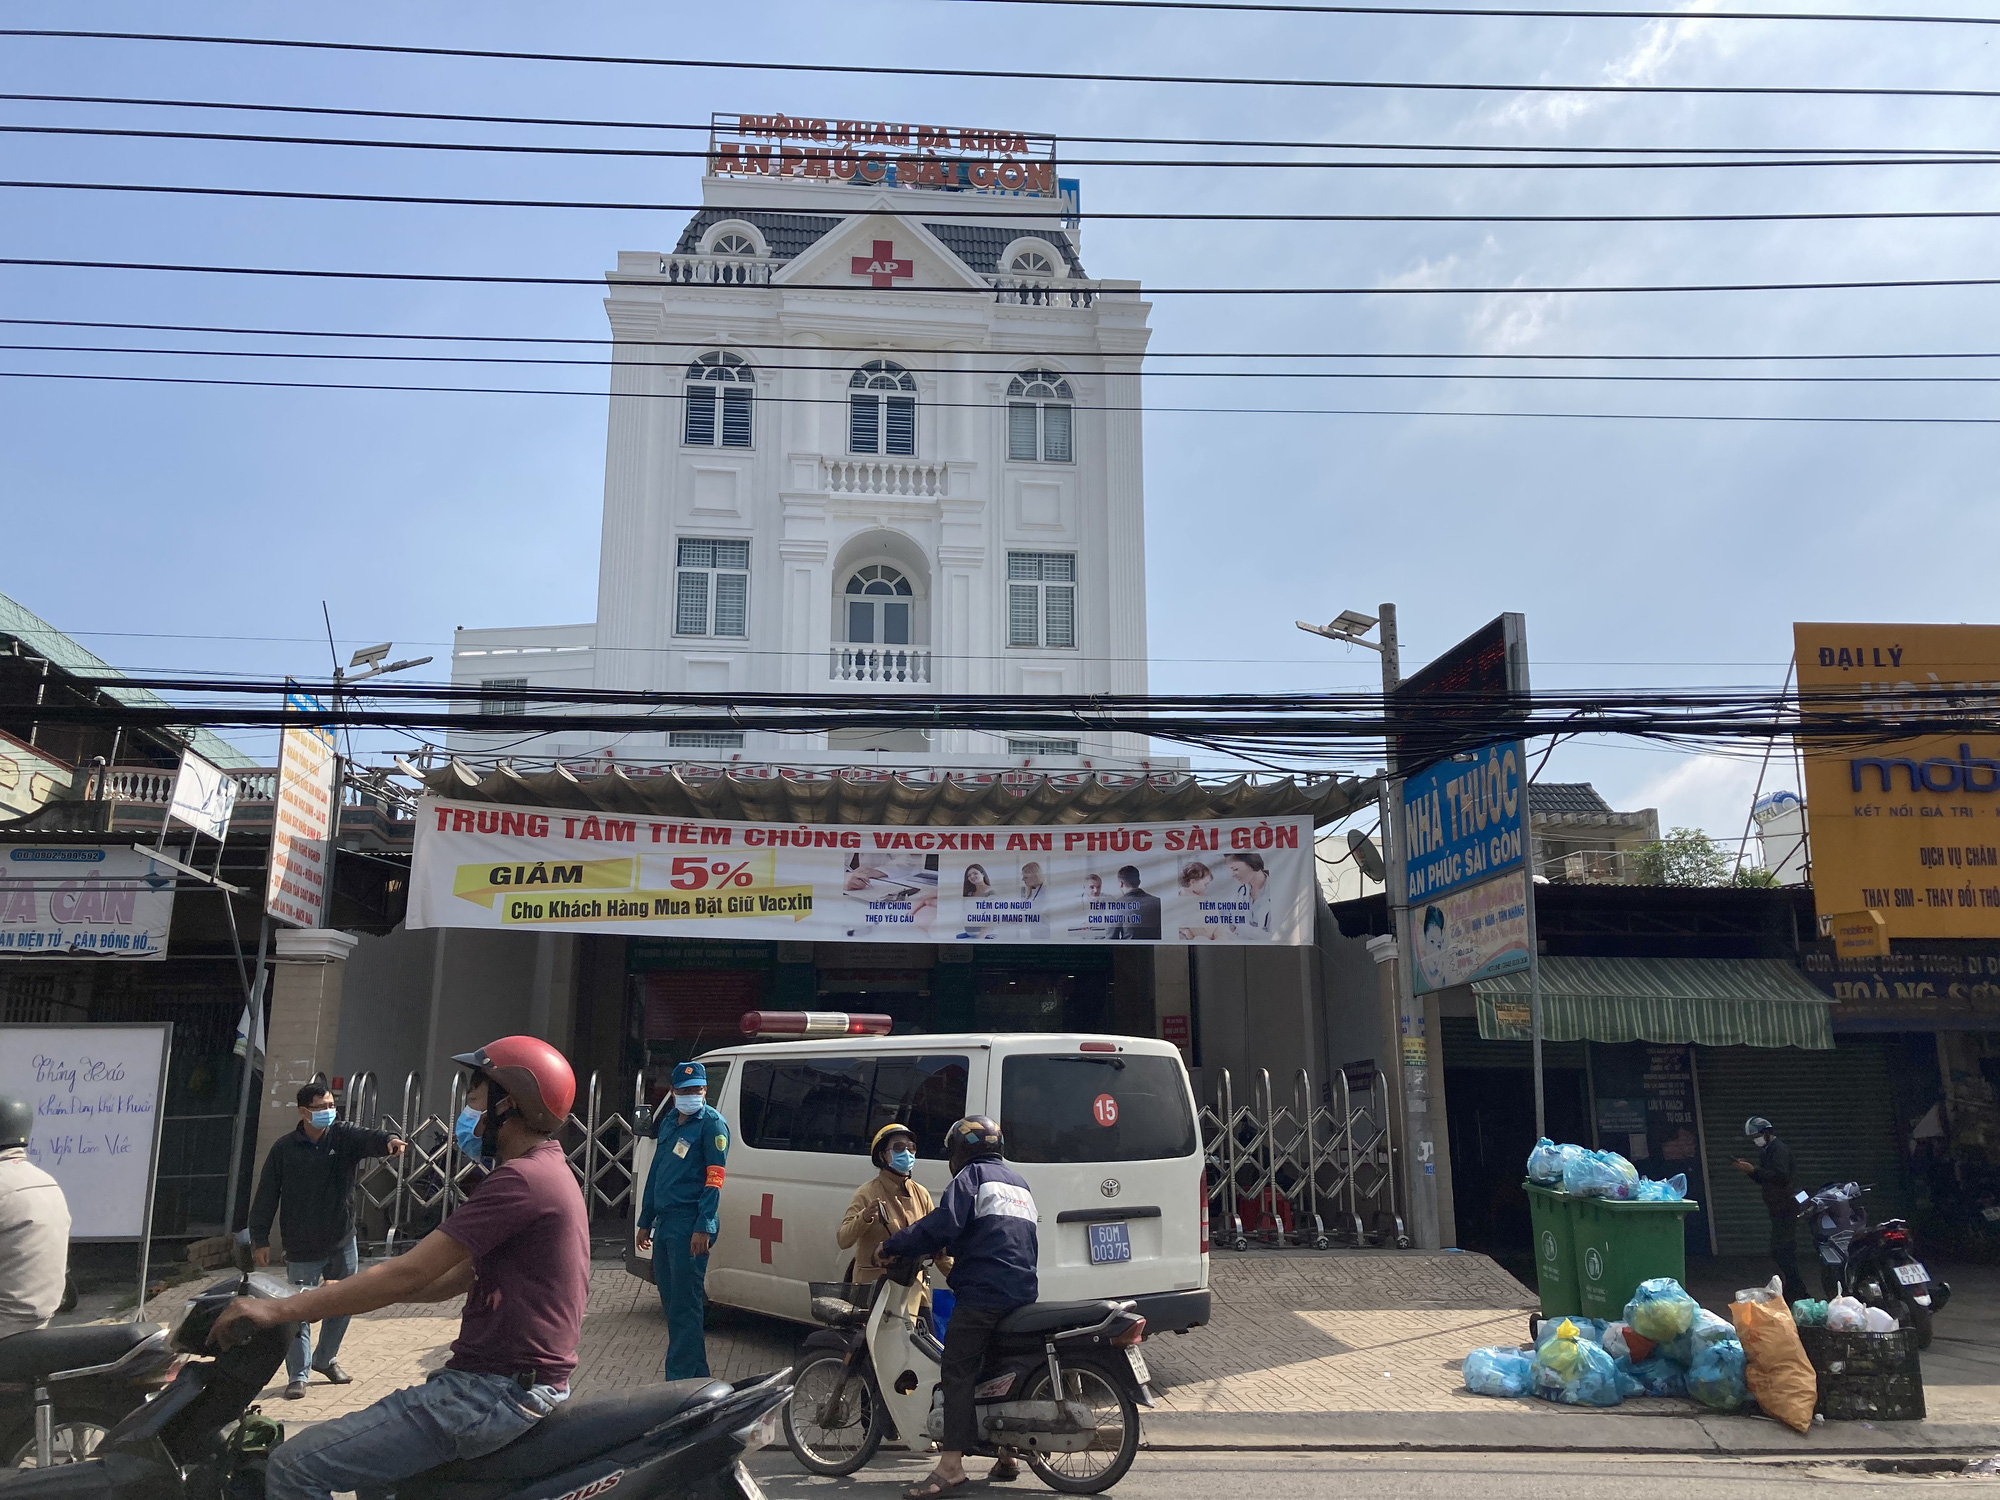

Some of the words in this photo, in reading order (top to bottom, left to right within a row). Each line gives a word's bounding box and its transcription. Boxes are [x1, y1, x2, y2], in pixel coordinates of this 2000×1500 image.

[739, 112, 827, 142] PHÒNG
[960, 128, 1029, 154] KHOA
[715, 144, 772, 175] AN
[781, 143, 887, 182] PHÚC
[896, 149, 959, 187] SÀI
[968, 153, 1052, 192] GÒN
[866, 261, 899, 273] AP
[1819, 647, 1864, 671] ĐẠI
[1873, 644, 1903, 668] LÝ
[1851, 742, 2000, 793] mob
[1405, 776, 1444, 861] NHÀ
[1854, 804, 1881, 817] KẾT
[1889, 804, 1913, 817] NỐI
[1920, 804, 1944, 817] GIÁ
[434, 806, 549, 838] TRUNG
[562, 815, 637, 842] TÂM
[648, 822, 732, 846] TIÊM
[744, 825, 861, 849] CHỦNG
[872, 831, 995, 850] VACXIN
[1006, 833, 1053, 851] AN
[1064, 828, 1153, 852] PHÚC
[1165, 825, 1219, 851] SÀI
[1231, 821, 1298, 850] GÒN
[1409, 868, 1425, 898] AN
[1428, 850, 1462, 891] PHÚC
[1464, 838, 1487, 876] SÀI
[1490, 827, 1522, 867] GÒN
[1920, 847, 1944, 869] DỊCH
[1948, 847, 1962, 869] VỤ
[1966, 844, 1998, 866] CHĂM
[489, 861, 584, 885] GIẢM
[670, 857, 753, 890] 5%
[50, 869, 138, 925] CÂN
[994, 901, 1009, 910] CHO
[1862, 888, 1890, 908] THAY
[1894, 888, 1914, 908] SIM
[1925, 888, 1953, 908] THAY
[1958, 879, 1977, 908] ĐỔI
[1979, 885, 2000, 908] THÔ
[511, 901, 543, 919] Cho
[548, 899, 601, 918] Khách
[607, 898, 649, 918] Hàng
[655, 898, 690, 915] Mua
[695, 896, 722, 918] Đặt
[727, 895, 755, 913] Giữ
[759, 893, 813, 911] Vacxin
[865, 914, 884, 923] THEO
[1001, 914, 1023, 924] MANG
[1024, 914, 1040, 924] THAI
[1088, 915, 1103, 924] CHO
[1204, 915, 1219, 924] CHO
[1234, 915, 1246, 924] EM
[17, 930, 44, 950] ĐIỆN
[47, 928, 63, 947] TỬ
[73, 931, 97, 948] CÂN
[100, 929, 130, 949] ĐỒNG
[1968, 956, 1982, 974] DI
[32, 1054, 77, 1093] Thông
[79, 1056, 125, 1082] Báo
[1096, 1099, 1116, 1121] 15
[1099, 1226, 1121, 1243] 60M
[1093, 1242, 1130, 1261] 003.75
